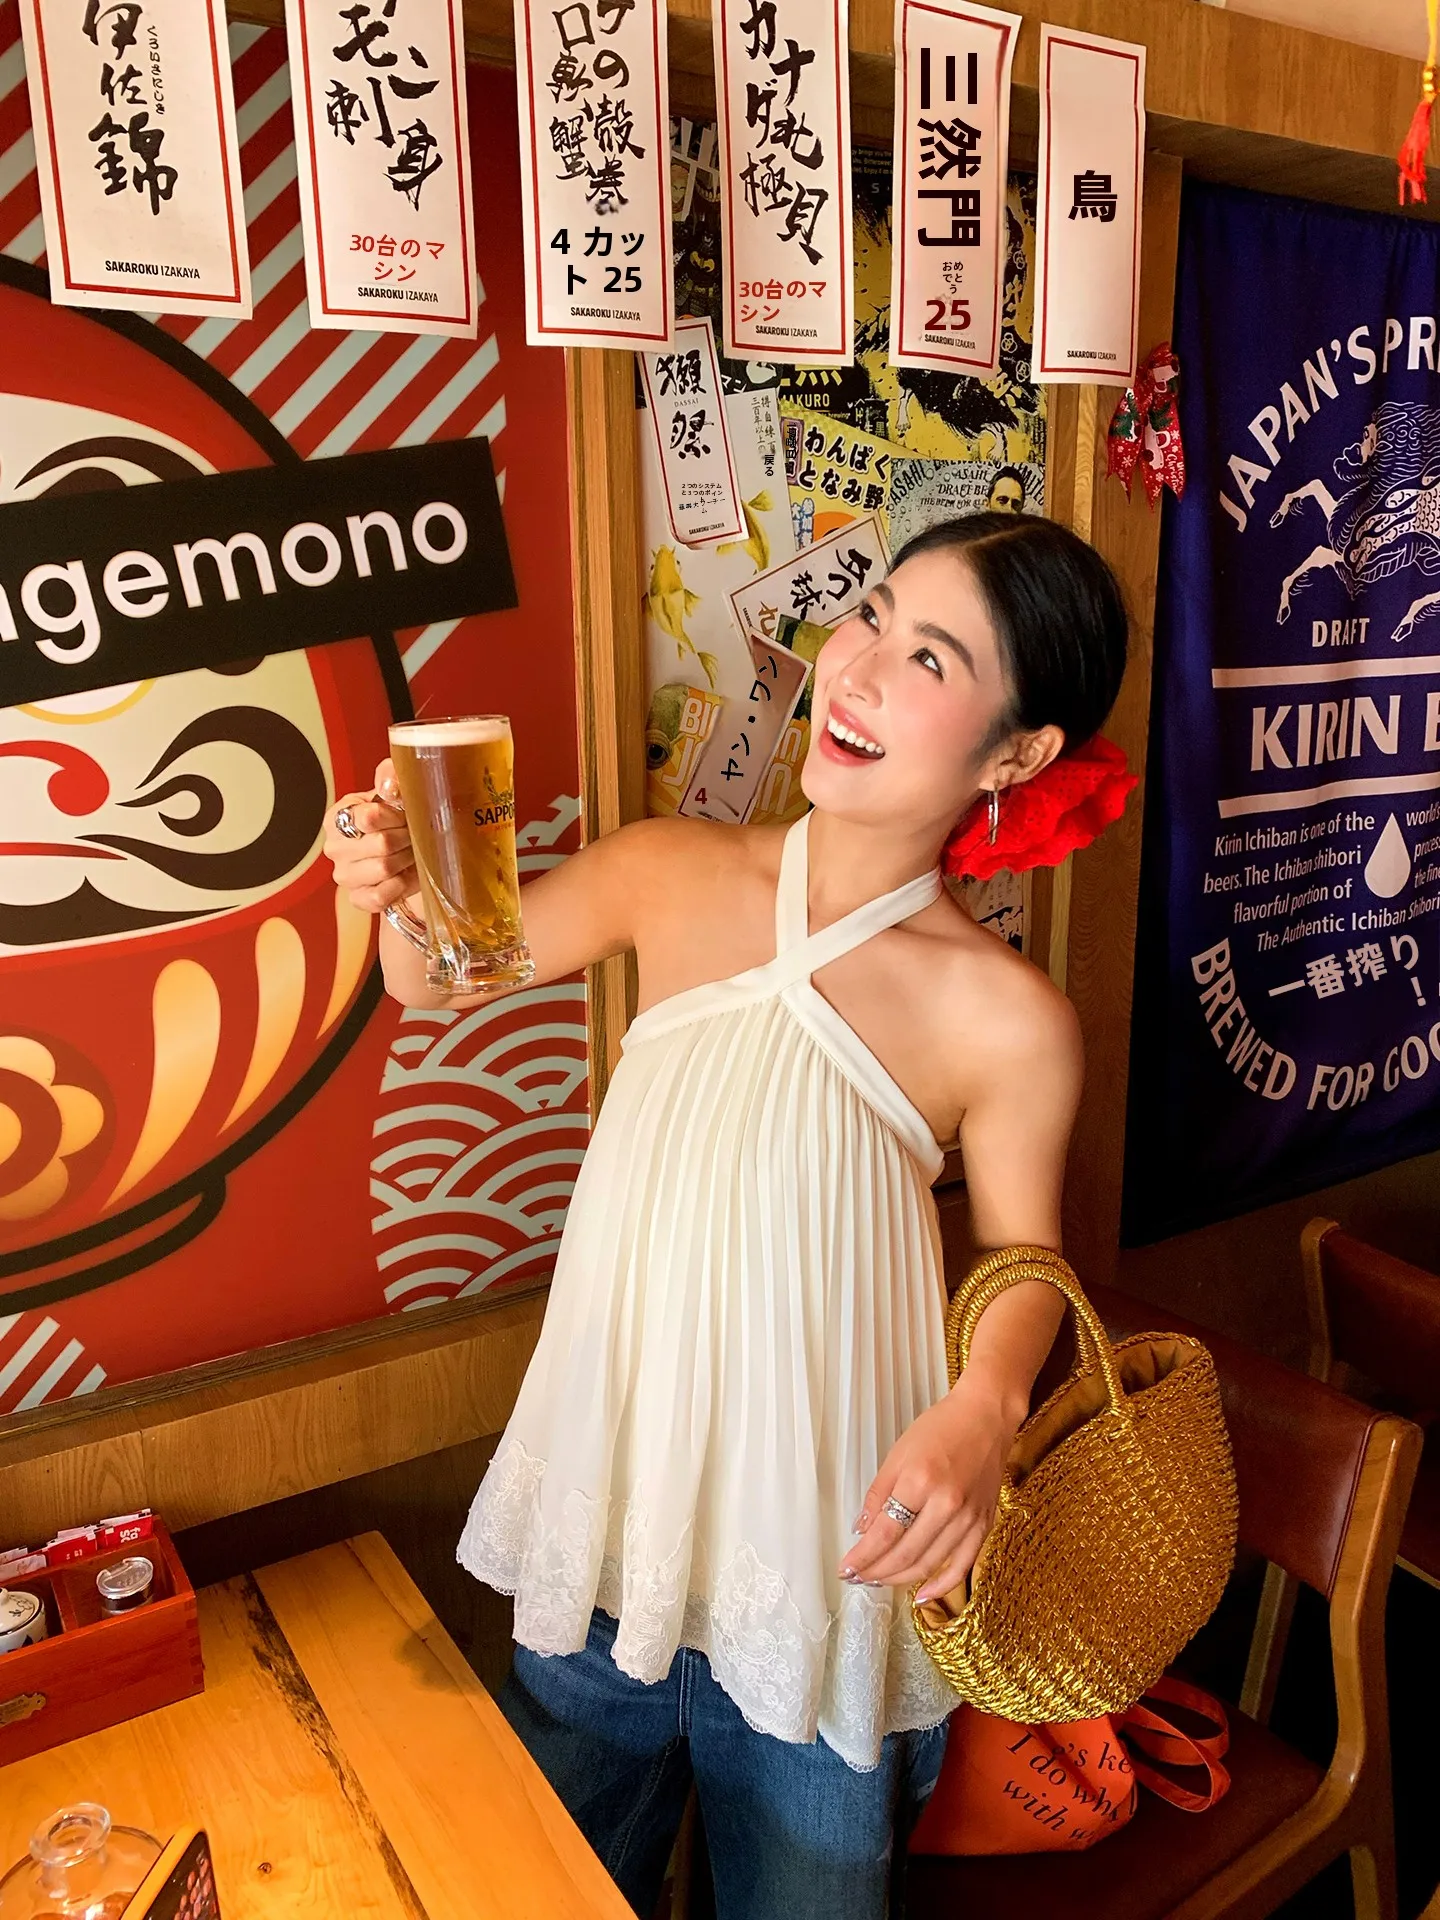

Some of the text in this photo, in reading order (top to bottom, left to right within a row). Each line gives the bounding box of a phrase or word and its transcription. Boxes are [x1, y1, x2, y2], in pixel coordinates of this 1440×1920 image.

[1068, 170, 1118, 222] 鳥
[349, 233, 446, 259] 30台のマ
[551, 226, 645, 257] 4 カッ
[105, 260, 200, 279] SAKAROKU IZAKAYA
[373, 262, 417, 282] シン
[567, 265, 642, 295] ト 25
[358, 287, 439, 303] SAKAROKU IZAKAYA
[739, 279, 828, 301] 30台のマ
[570, 307, 641, 321] SAKAROKU IZAKAYA
[740, 304, 781, 323] シン
[924, 300, 972, 331] 25
[755, 325, 818, 338] SAKAROKU IZAKAYA
[925, 334, 976, 350] SAKAROKU IZAKAYA
[1067, 350, 1097, 360] SAKAROKU
[674, 397, 700, 408] DASSAI
[1219, 316, 1440, 533] JAPAN'S PR
[803, 425, 892, 480] わんぱく
[797, 460, 887, 511] となみ野
[1312, 618, 1370, 647] DRAFT
[1250, 695, 1401, 772] KIRIN
[694, 787, 708, 805] 4
[474, 802, 516, 827] SAPPO
[1214, 833, 1243, 857] Kirin
[1245, 828, 1297, 852] Ichiban
[1300, 823, 1309, 843] is
[1310, 824, 1326, 839] one
[1328, 813, 1342, 834] of
[1345, 811, 1376, 832] the
[1203, 871, 1243, 894] beers.
[1244, 866, 1270, 887] The
[1274, 855, 1312, 883] Ichiban
[1313, 845, 1362, 871] shibori
[1233, 894, 1290, 924] flavorful
[1290, 883, 1329, 916] portion
[1333, 879, 1353, 900] of
[1257, 932, 1279, 953] The
[1281, 911, 1345, 946] Authentic
[1351, 907, 1406, 932] Ichiban
[1191, 937, 1297, 1101] BREWED
[1306, 1062, 1375, 1112] FOR
[1029, 1751, 1067, 1786] do
[1002, 1779, 1069, 1833] with
